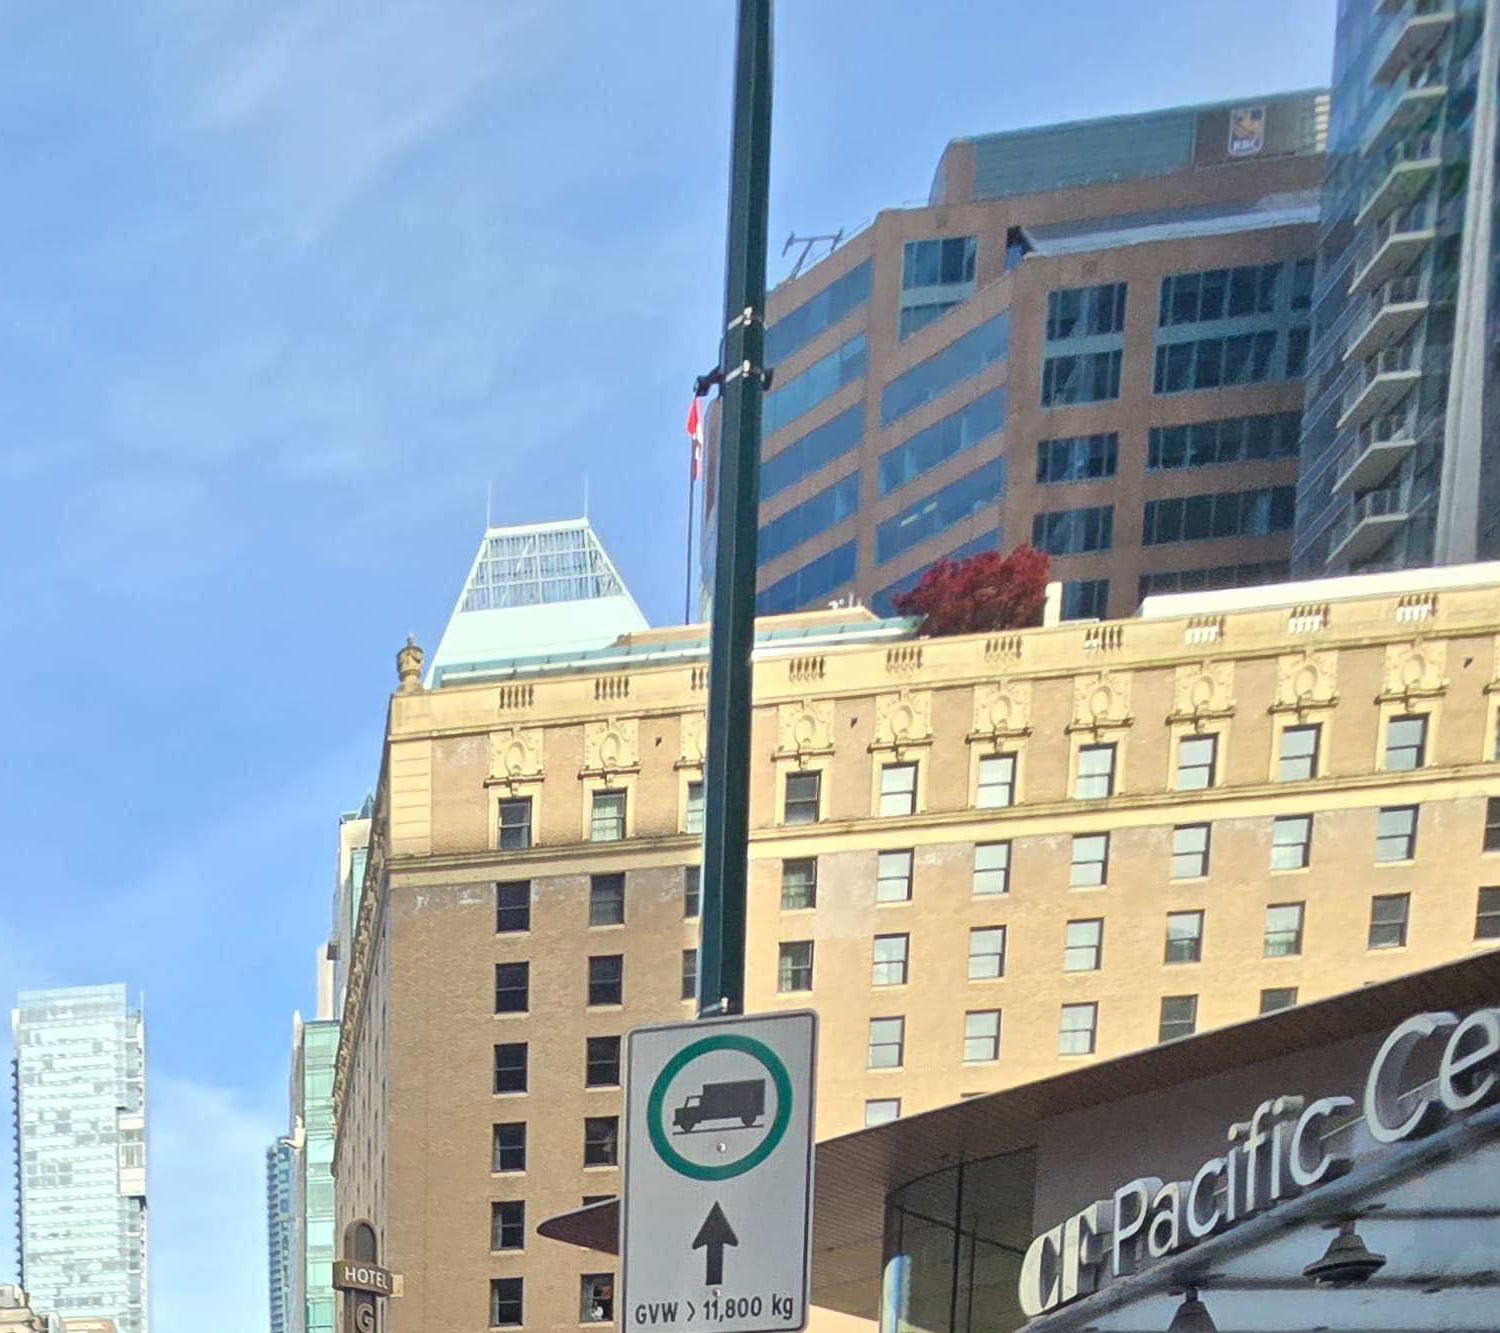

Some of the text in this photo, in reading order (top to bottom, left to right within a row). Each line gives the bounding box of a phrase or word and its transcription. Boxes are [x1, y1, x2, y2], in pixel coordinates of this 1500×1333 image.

[1019, 1201, 1105, 1317] CF
[1112, 1096, 1355, 1276] Pacific
[344, 1266, 388, 1289] HOTEL
[635, 1293, 793, 1325] GVW > 11,800 kg
